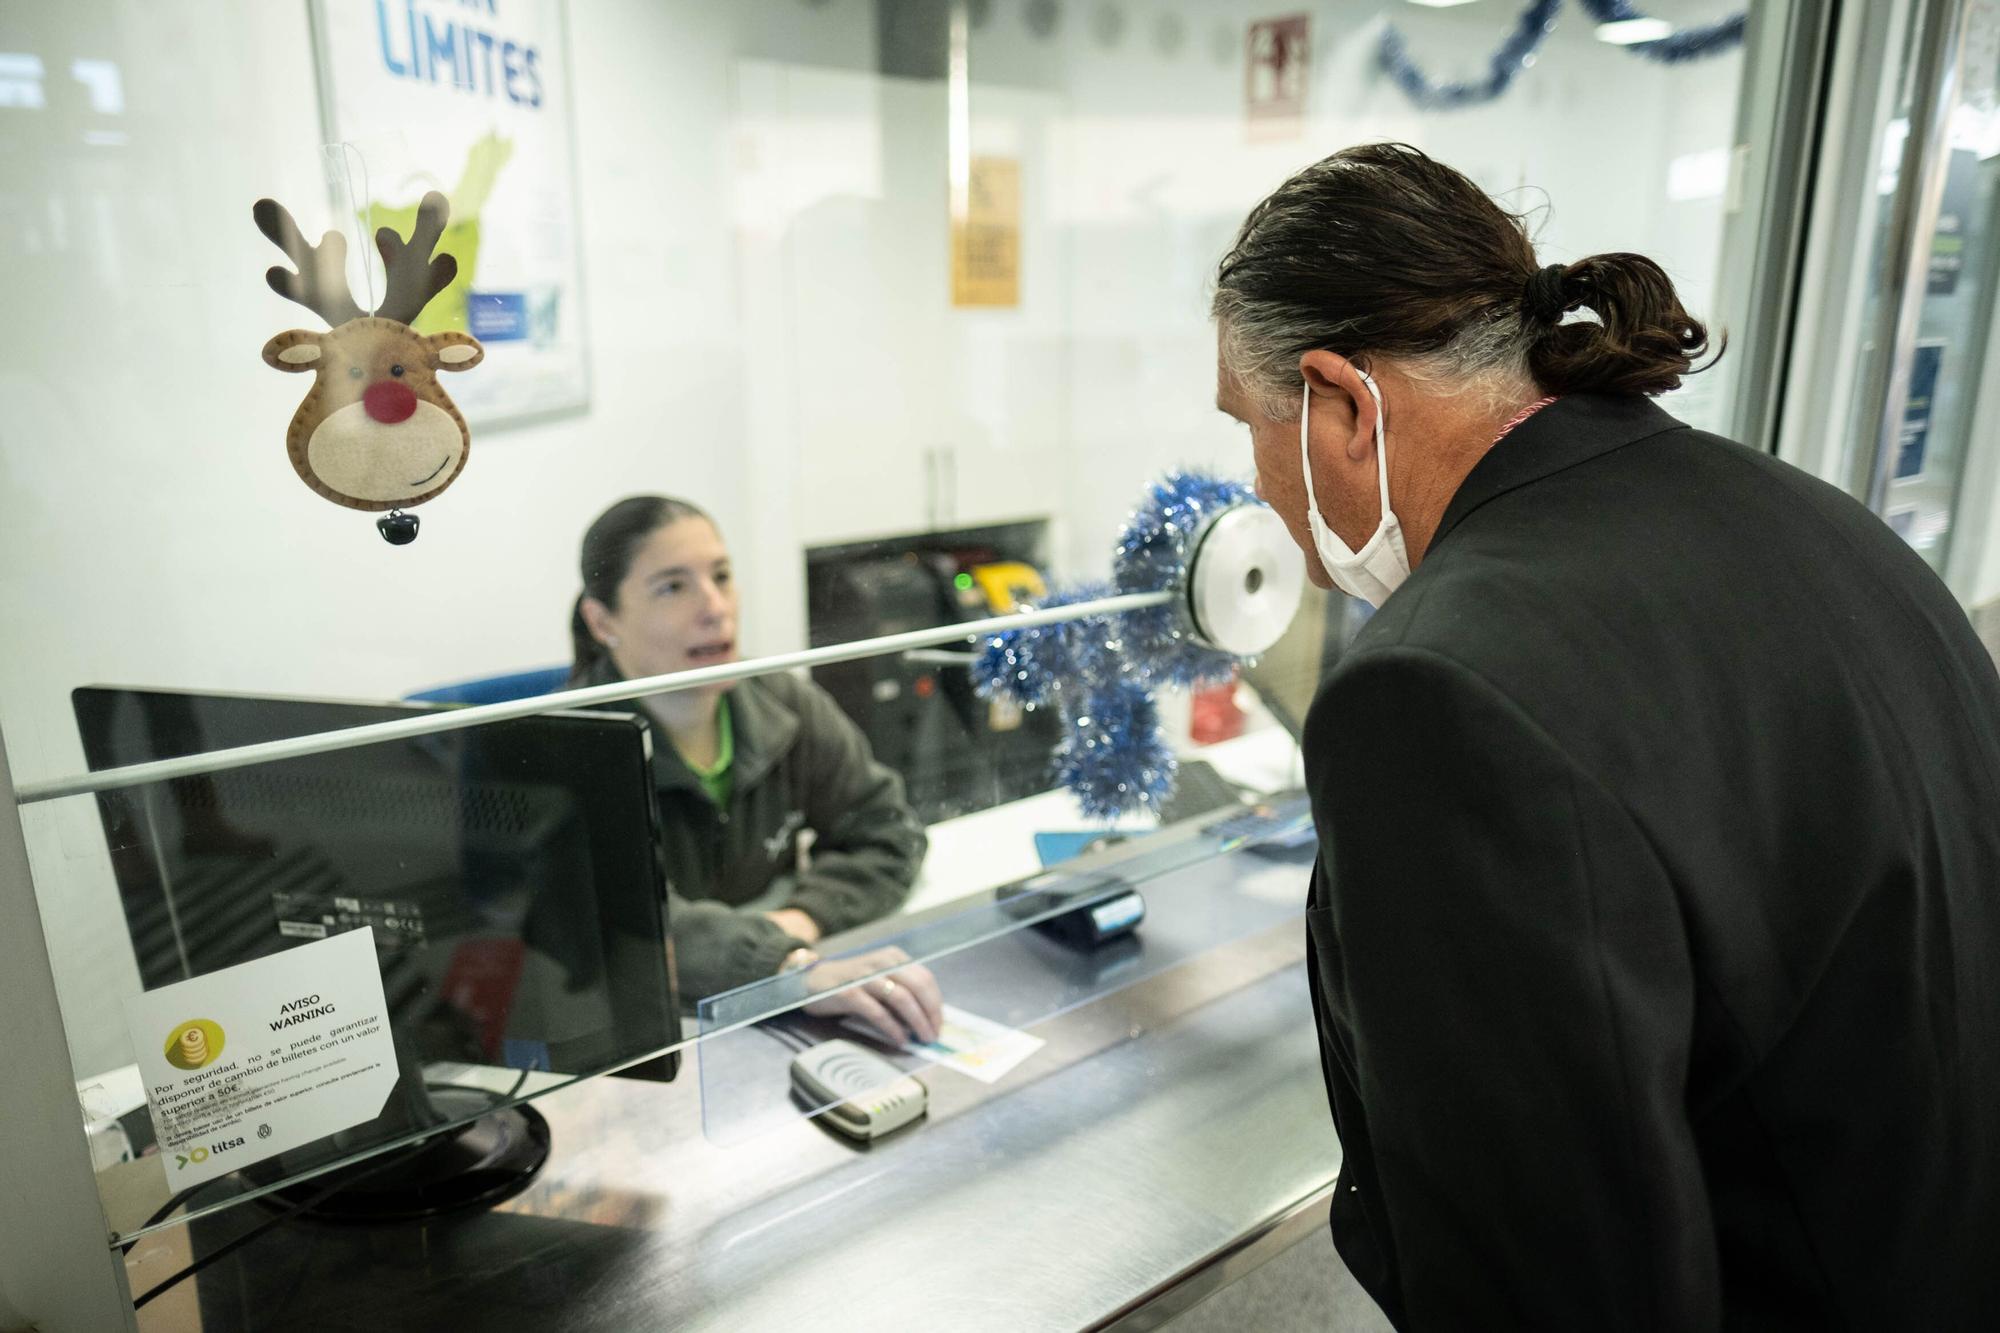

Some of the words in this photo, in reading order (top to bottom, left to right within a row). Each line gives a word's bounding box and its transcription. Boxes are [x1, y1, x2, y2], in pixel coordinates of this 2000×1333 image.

[270, 1003, 336, 1032] WARNING
[280, 994, 320, 1015] AVISO
[154, 1083, 174, 1096] Por
[247, 1055, 262, 1065] no
[270, 1047, 282, 1056] se
[290, 1033, 322, 1052] puede
[329, 1014, 379, 1038] garantizar
[158, 1085, 206, 1106] disponer
[208, 1079, 221, 1089] de
[224, 1066, 264, 1083] cambio
[266, 1056, 279, 1070] de
[281, 1046, 318, 1064] billetes
[319, 1040, 339, 1051] con
[341, 1035, 355, 1044] un
[356, 1025, 380, 1038] valor
[160, 1095, 208, 1117] superior
[209, 1093, 215, 1101] a
[217, 1084, 241, 1098] 50€.
[211, 1136, 246, 1155] titsa
